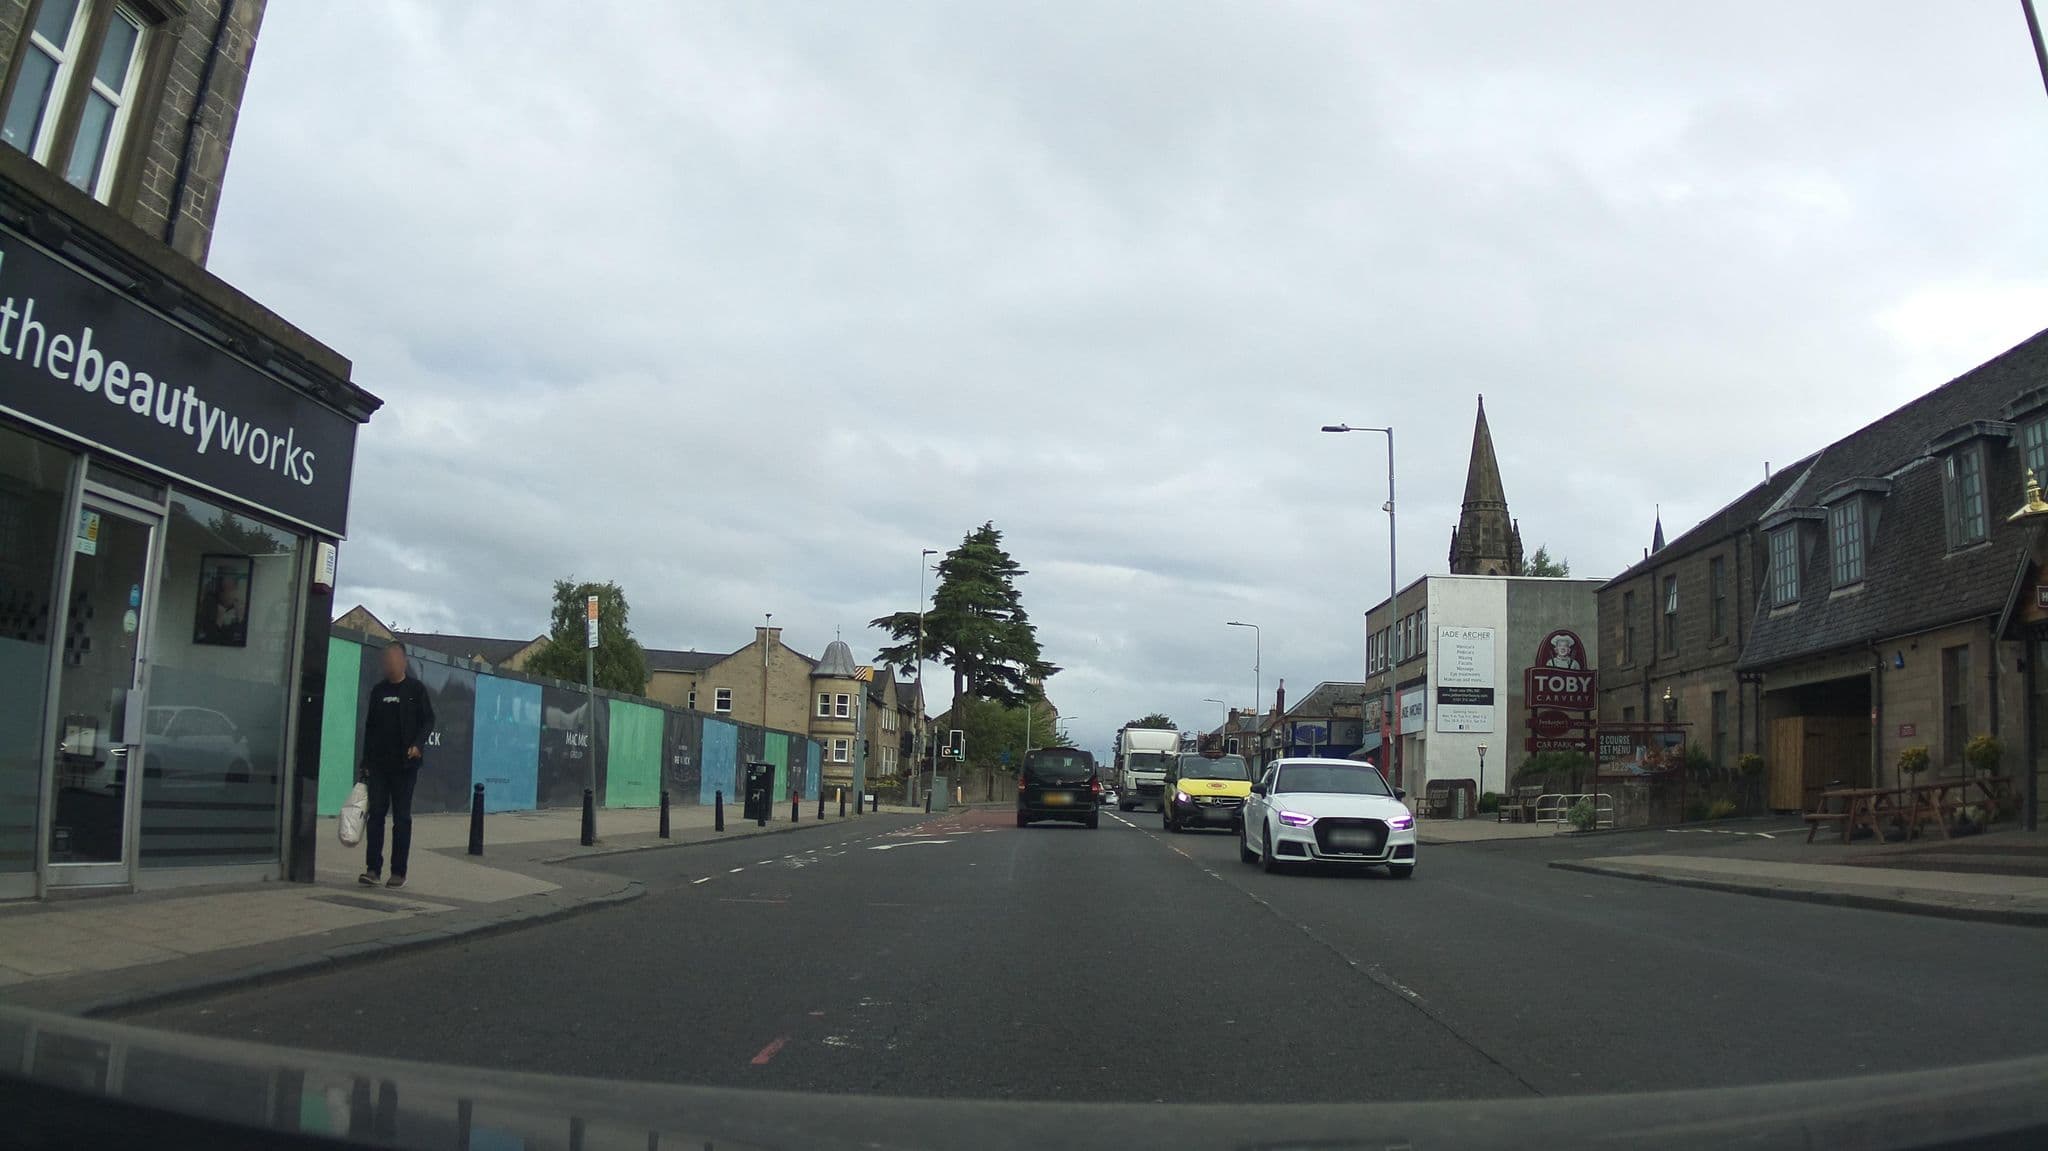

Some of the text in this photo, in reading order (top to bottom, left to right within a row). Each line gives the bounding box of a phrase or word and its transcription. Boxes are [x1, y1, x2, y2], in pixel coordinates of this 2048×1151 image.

[0, 297, 315, 486] thebeautyworks
[1534, 676, 1592, 692] TOBY
[1536, 741, 1553, 749] CAR
[1600, 735, 1630, 745] 2 COURSE
[1600, 745, 1631, 755] SET MENU
